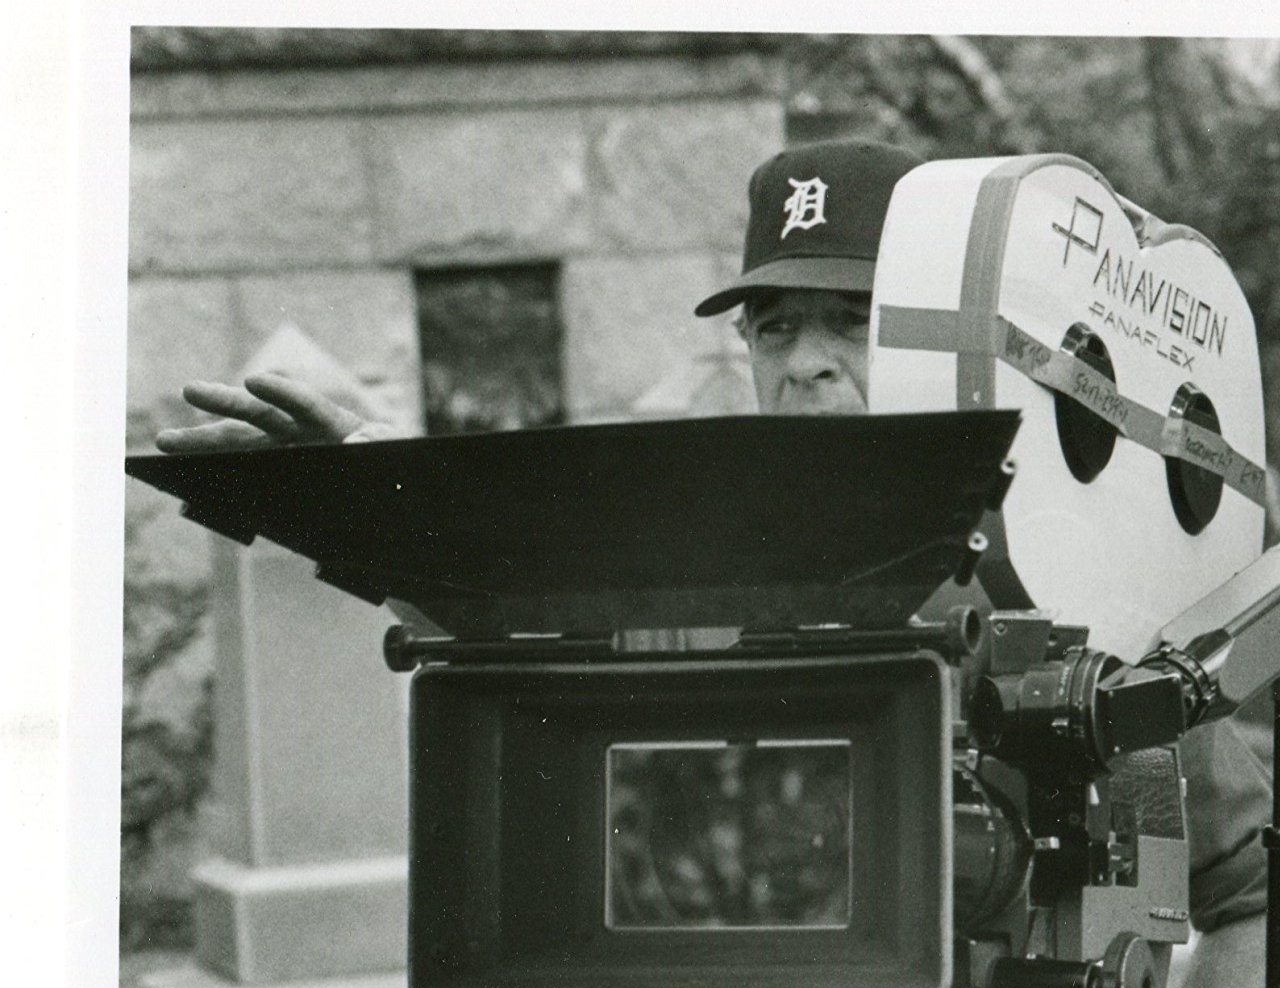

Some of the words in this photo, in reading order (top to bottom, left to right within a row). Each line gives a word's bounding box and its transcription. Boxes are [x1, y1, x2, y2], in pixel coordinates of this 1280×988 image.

[781, 176, 829, 239] D
[1051, 195, 1228, 359] PANAVISION
[1088, 300, 1195, 373] PANAFLEX
